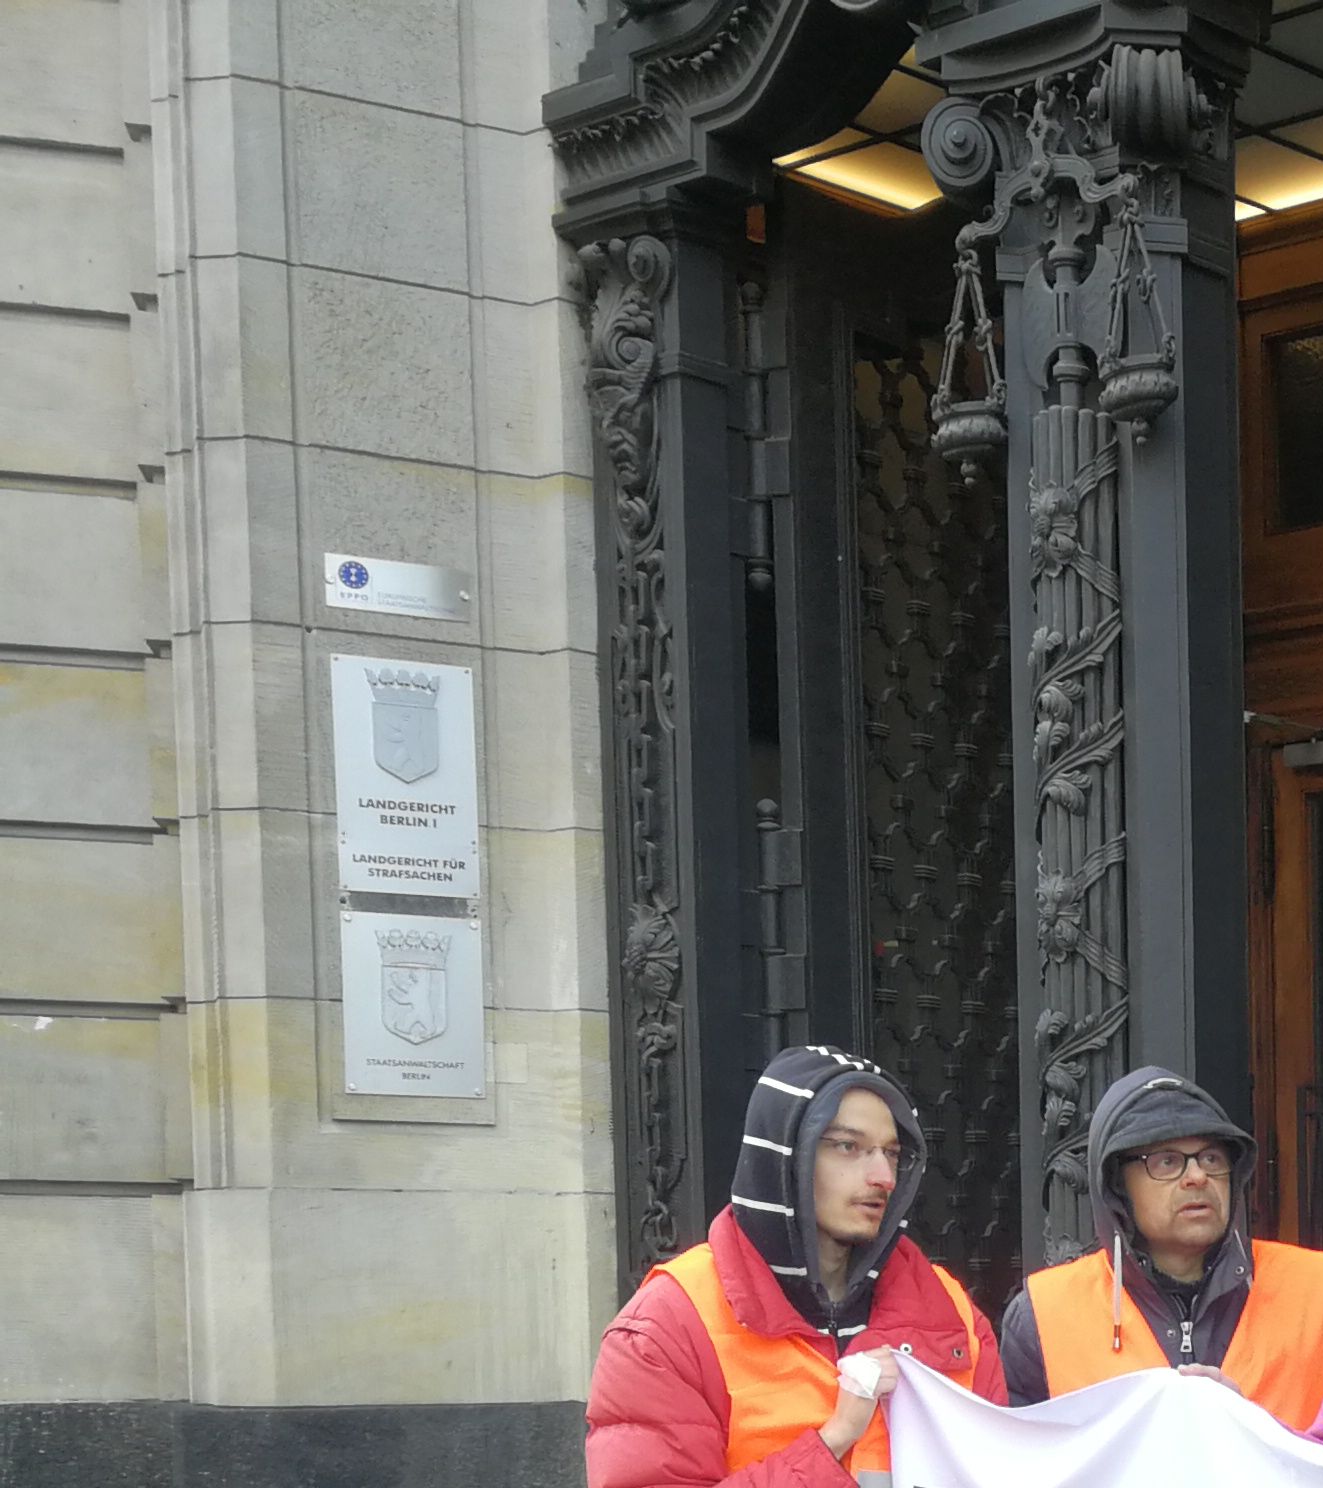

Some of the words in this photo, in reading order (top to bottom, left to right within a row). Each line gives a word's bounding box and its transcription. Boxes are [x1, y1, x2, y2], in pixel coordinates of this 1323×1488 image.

[358, 797, 457, 815] LANDGERICHT
[379, 813, 428, 828] BERLIN
[352, 853, 440, 868] LANDGERICHT
[442, 857, 467, 870] FÜR
[367, 867, 454, 882] STRAFSACHEN
